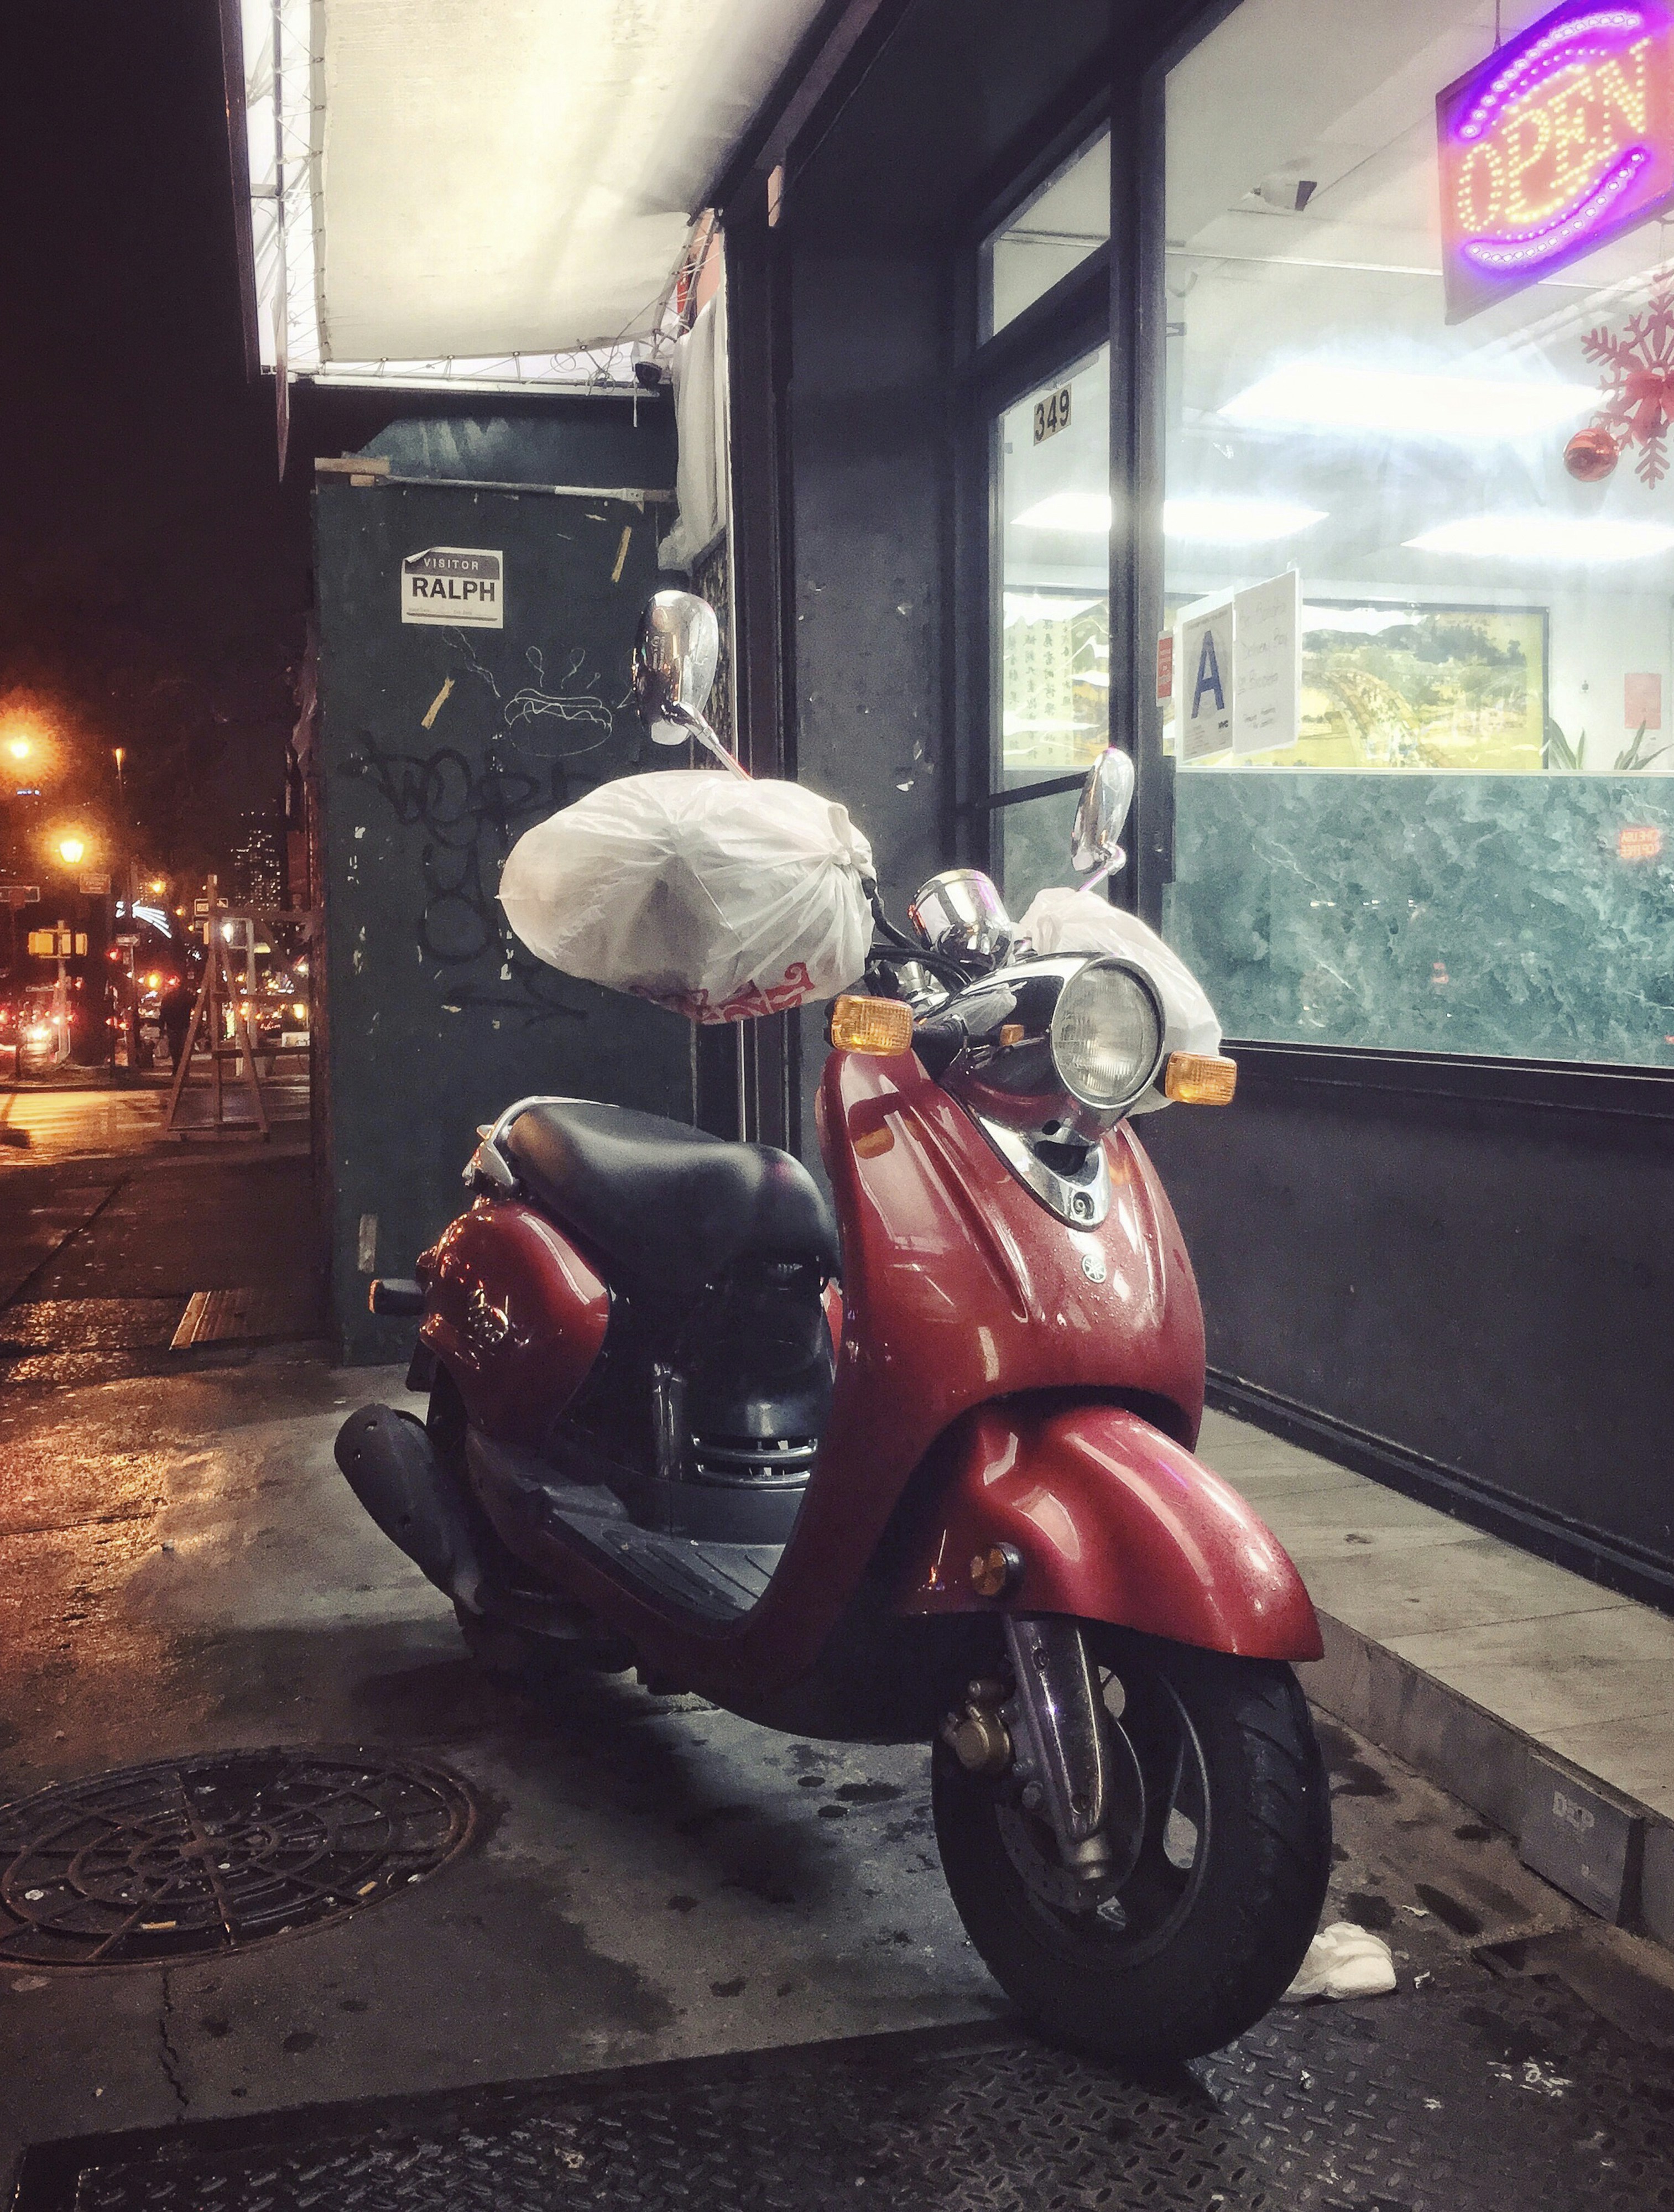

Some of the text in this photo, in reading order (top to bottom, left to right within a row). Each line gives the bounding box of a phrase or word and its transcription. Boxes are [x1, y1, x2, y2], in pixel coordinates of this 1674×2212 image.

[1458, 39, 1649, 231] OPEN
[1035, 389, 1069, 441] 349
[412, 577, 494, 601] RALPH
[424, 558, 478, 570] VISITOR
[1191, 630, 1225, 719] A
